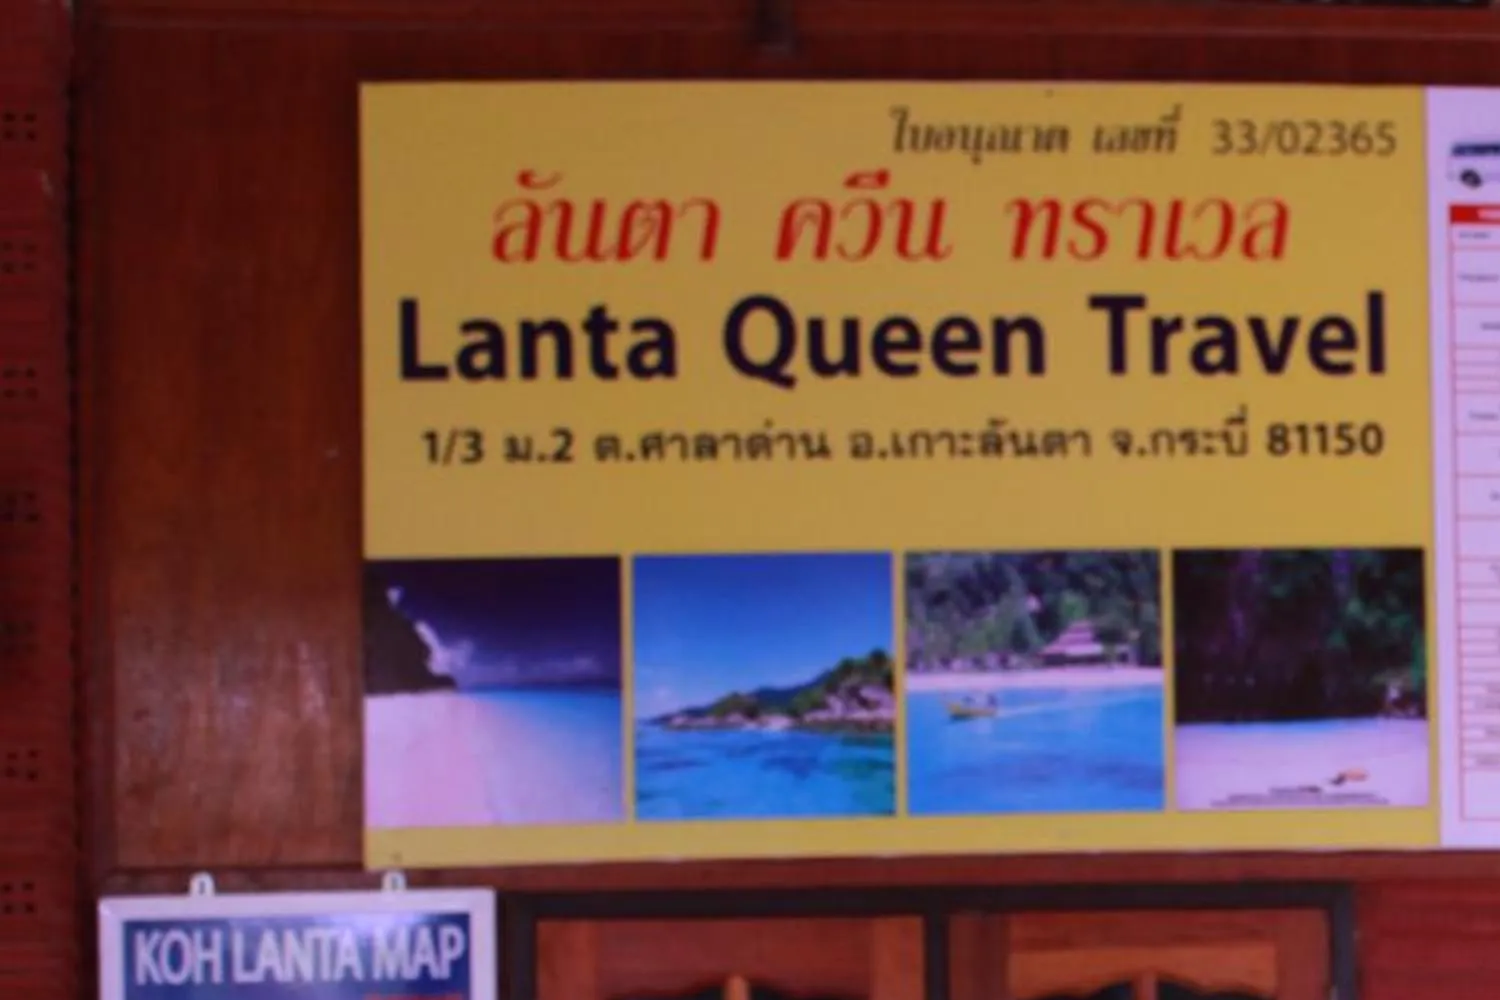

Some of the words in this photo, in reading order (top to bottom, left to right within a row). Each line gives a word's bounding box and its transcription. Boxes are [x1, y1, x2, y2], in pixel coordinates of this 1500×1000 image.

[1209, 119, 1398, 159] 33/02365
[490, 166, 723, 264] ลันตา
[773, 166, 957, 262] ควีน
[1003, 195, 1292, 262] ทราเวล
[399, 296, 678, 382] Lanta
[721, 294, 1047, 388] Queen
[1088, 291, 1387, 377] Travel
[421, 428, 486, 467] 1/3
[503, 428, 575, 462] ม.2
[594, 417, 831, 461] ต.ศาลาด่าน
[848, 416, 1093, 460] อ.เกาะลันตา
[1110, 402, 1249, 458] จ.กระบี่
[1265, 421, 1386, 457] 81150
[134, 928, 225, 986] KOH
[232, 926, 363, 983] LANTA
[372, 924, 466, 981] MAP
